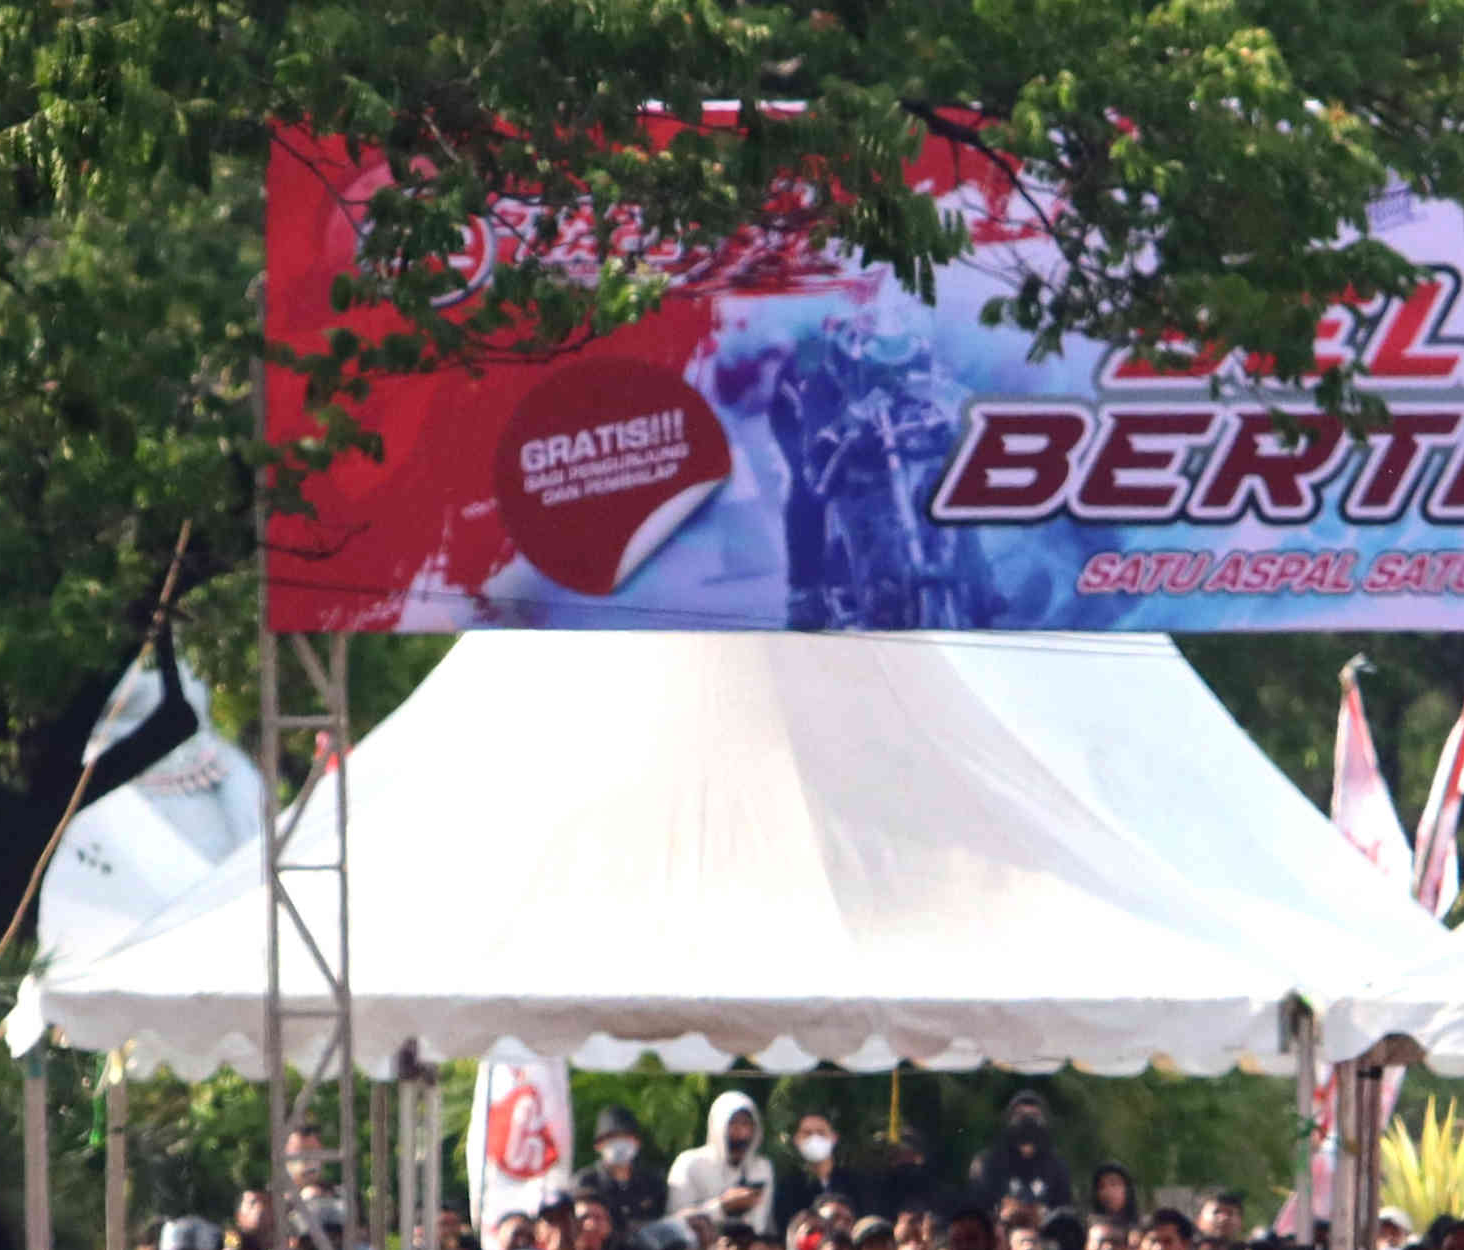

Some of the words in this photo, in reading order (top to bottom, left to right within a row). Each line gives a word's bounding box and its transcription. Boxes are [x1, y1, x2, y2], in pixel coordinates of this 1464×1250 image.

[520, 407, 685, 474] GRATIS!!!
[1077, 552, 1209, 595] SATU
[1204, 552, 1353, 594] ASPAL
